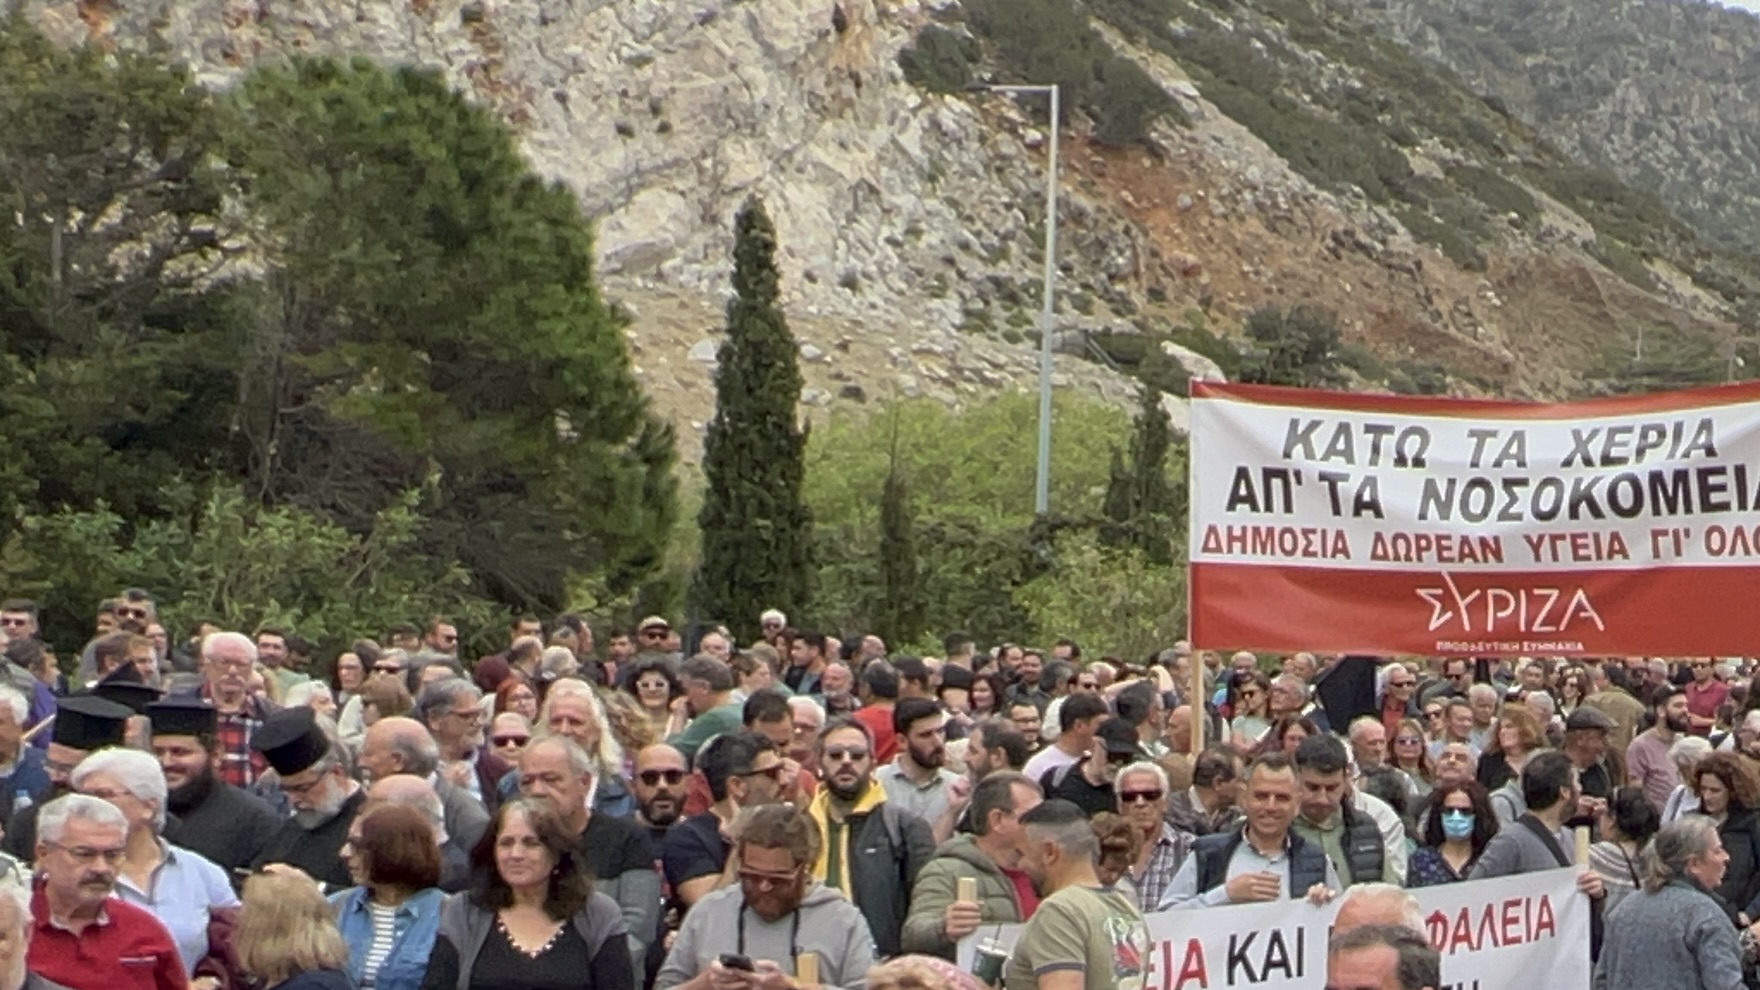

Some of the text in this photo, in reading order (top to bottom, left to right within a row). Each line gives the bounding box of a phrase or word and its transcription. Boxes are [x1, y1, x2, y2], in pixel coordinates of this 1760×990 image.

[1282, 417, 1719, 469] ΚΑΤΩ ΤΑ ΧΕΡΙΑ
[1226, 466, 1303, 513] ΑΠ'
[1319, 470, 1384, 520] ΤΑ
[1201, 523, 1351, 561] ΔΗΜΟΣΙΑ
[1370, 531, 1505, 564] ΔΩΡΕΑΝ
[1523, 530, 1630, 563] ΥΓΕΙΑ
[1650, 527, 1691, 559] ΓΙ'
[1415, 570, 1605, 632] ΣΥΡΙΖΑ
[1226, 926, 1304, 986] ΚΑΙ
